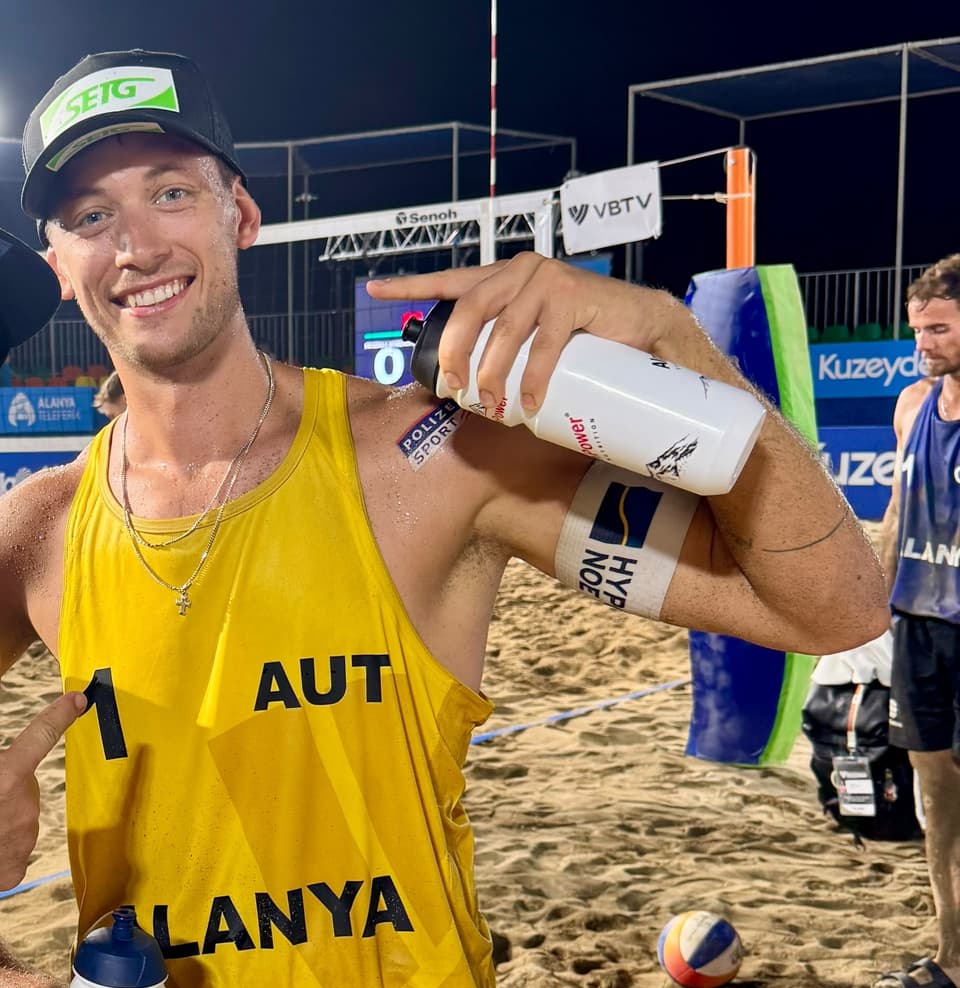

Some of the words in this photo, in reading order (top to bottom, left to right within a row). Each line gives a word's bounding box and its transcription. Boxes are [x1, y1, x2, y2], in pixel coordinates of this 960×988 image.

[61, 77, 156, 126] SETG
[410, 209, 457, 224] Senoh
[594, 193, 652, 219] VBTV
[373, 347, 405, 385] 0
[402, 401, 456, 451] POLIZE
[413, 418, 459, 465] SPORT
[578, 548, 610, 599] NOE
[900, 537, 960, 568] LAN
[602, 555, 638, 609] HYP
[254, 654, 392, 712] AUT
[78, 667, 129, 761] 1
[120, 875, 415, 960] LANYA
